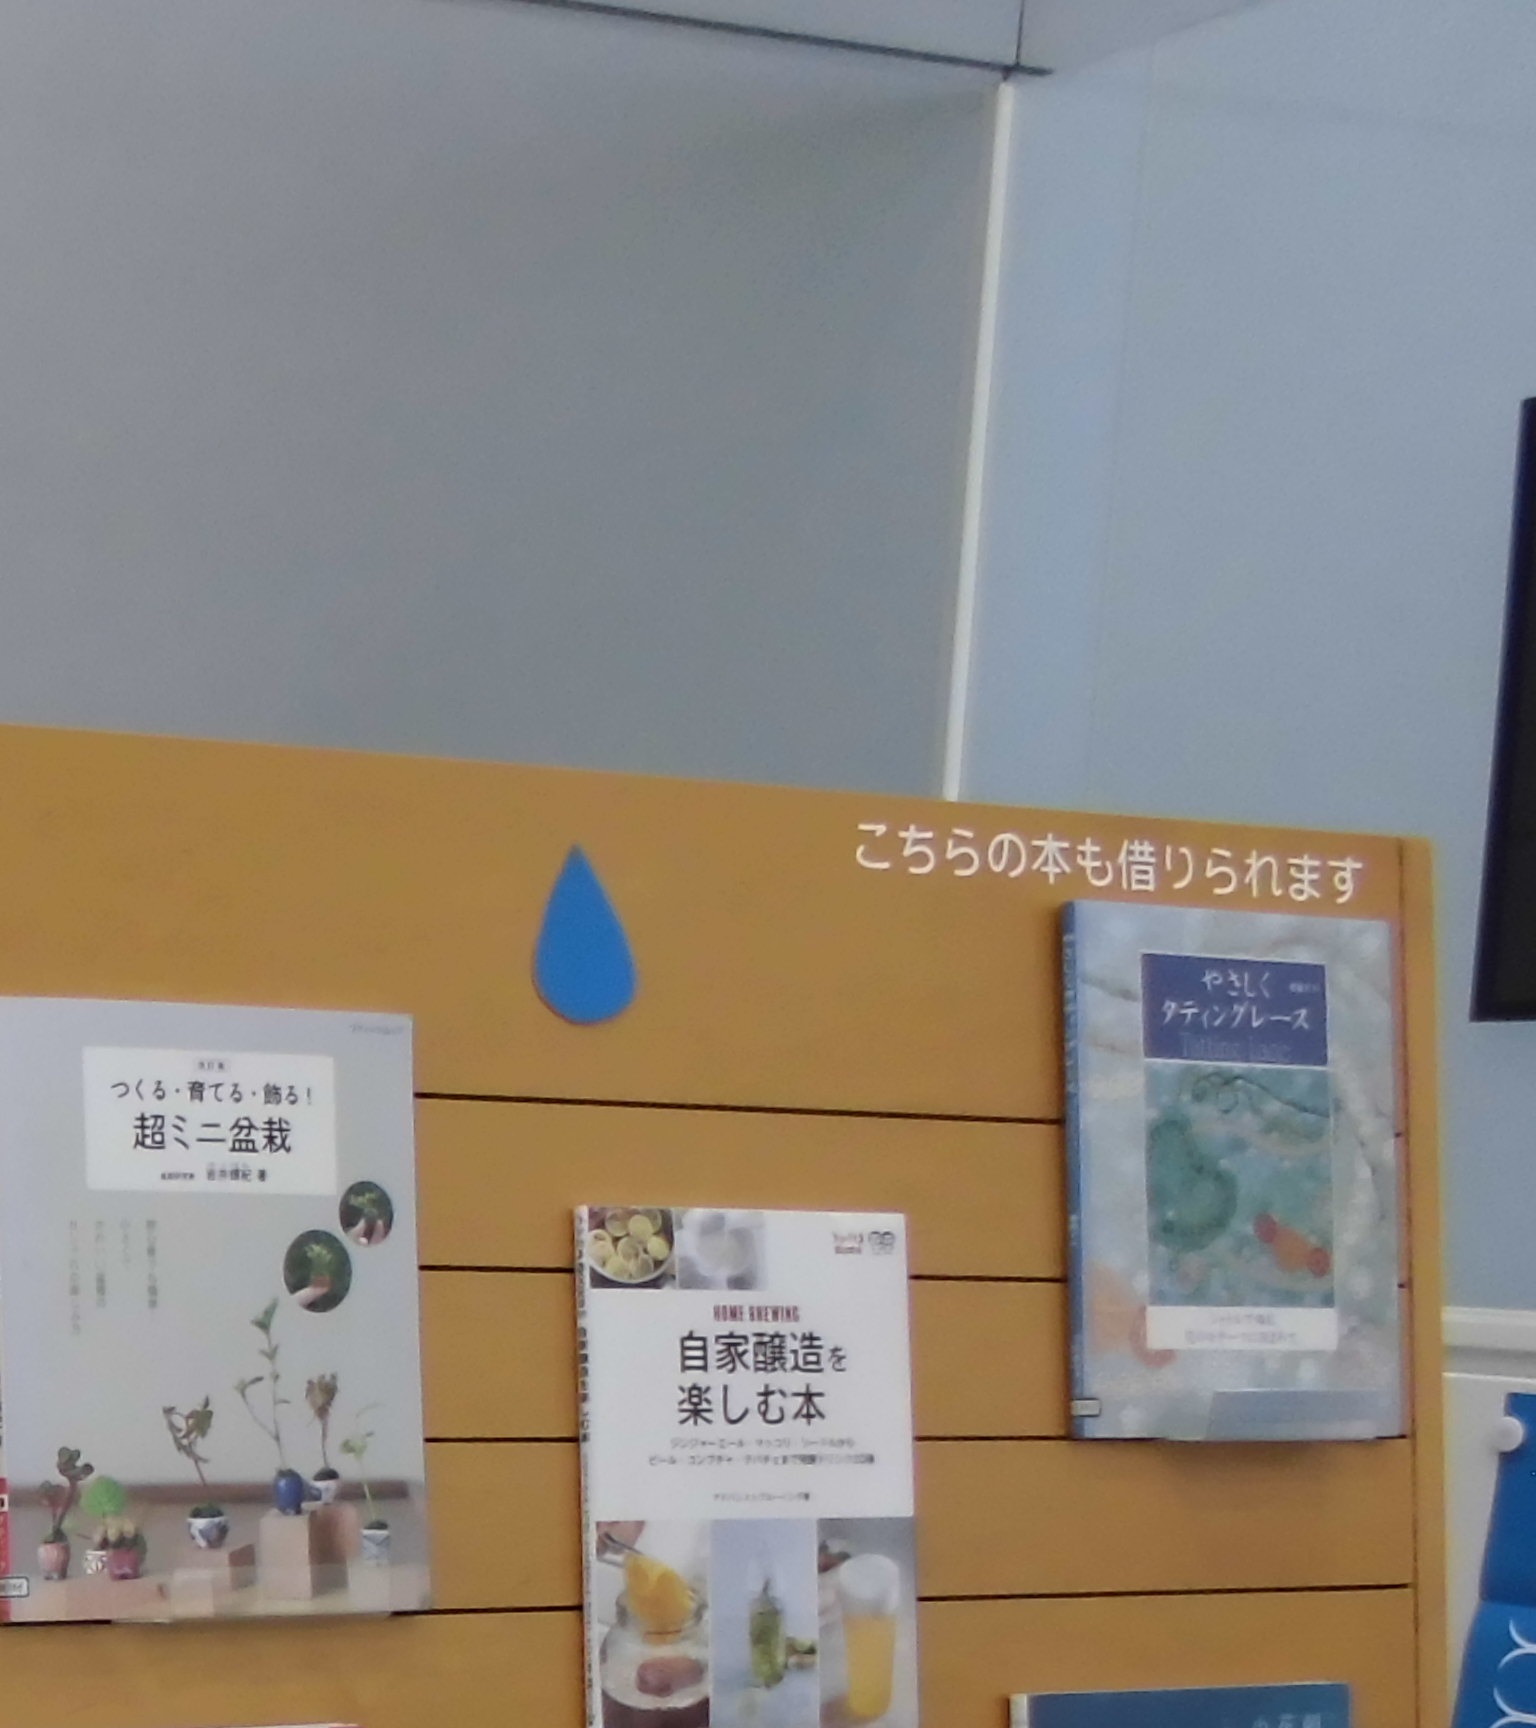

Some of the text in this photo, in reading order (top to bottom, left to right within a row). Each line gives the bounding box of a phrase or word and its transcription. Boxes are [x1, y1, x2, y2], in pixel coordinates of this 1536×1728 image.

[855, 823, 1363, 904] こちらの本も借りられます
[1200, 969, 1270, 998] やさしく
[1162, 1000, 1310, 1030] タティングレース
[133, 1113, 293, 1154] 超ミニ盆栽
[713, 1305, 800, 1322] HOME BREWING
[680, 1330, 847, 1373] 自家醸造を
[678, 1383, 826, 1426] 楽しむ本
